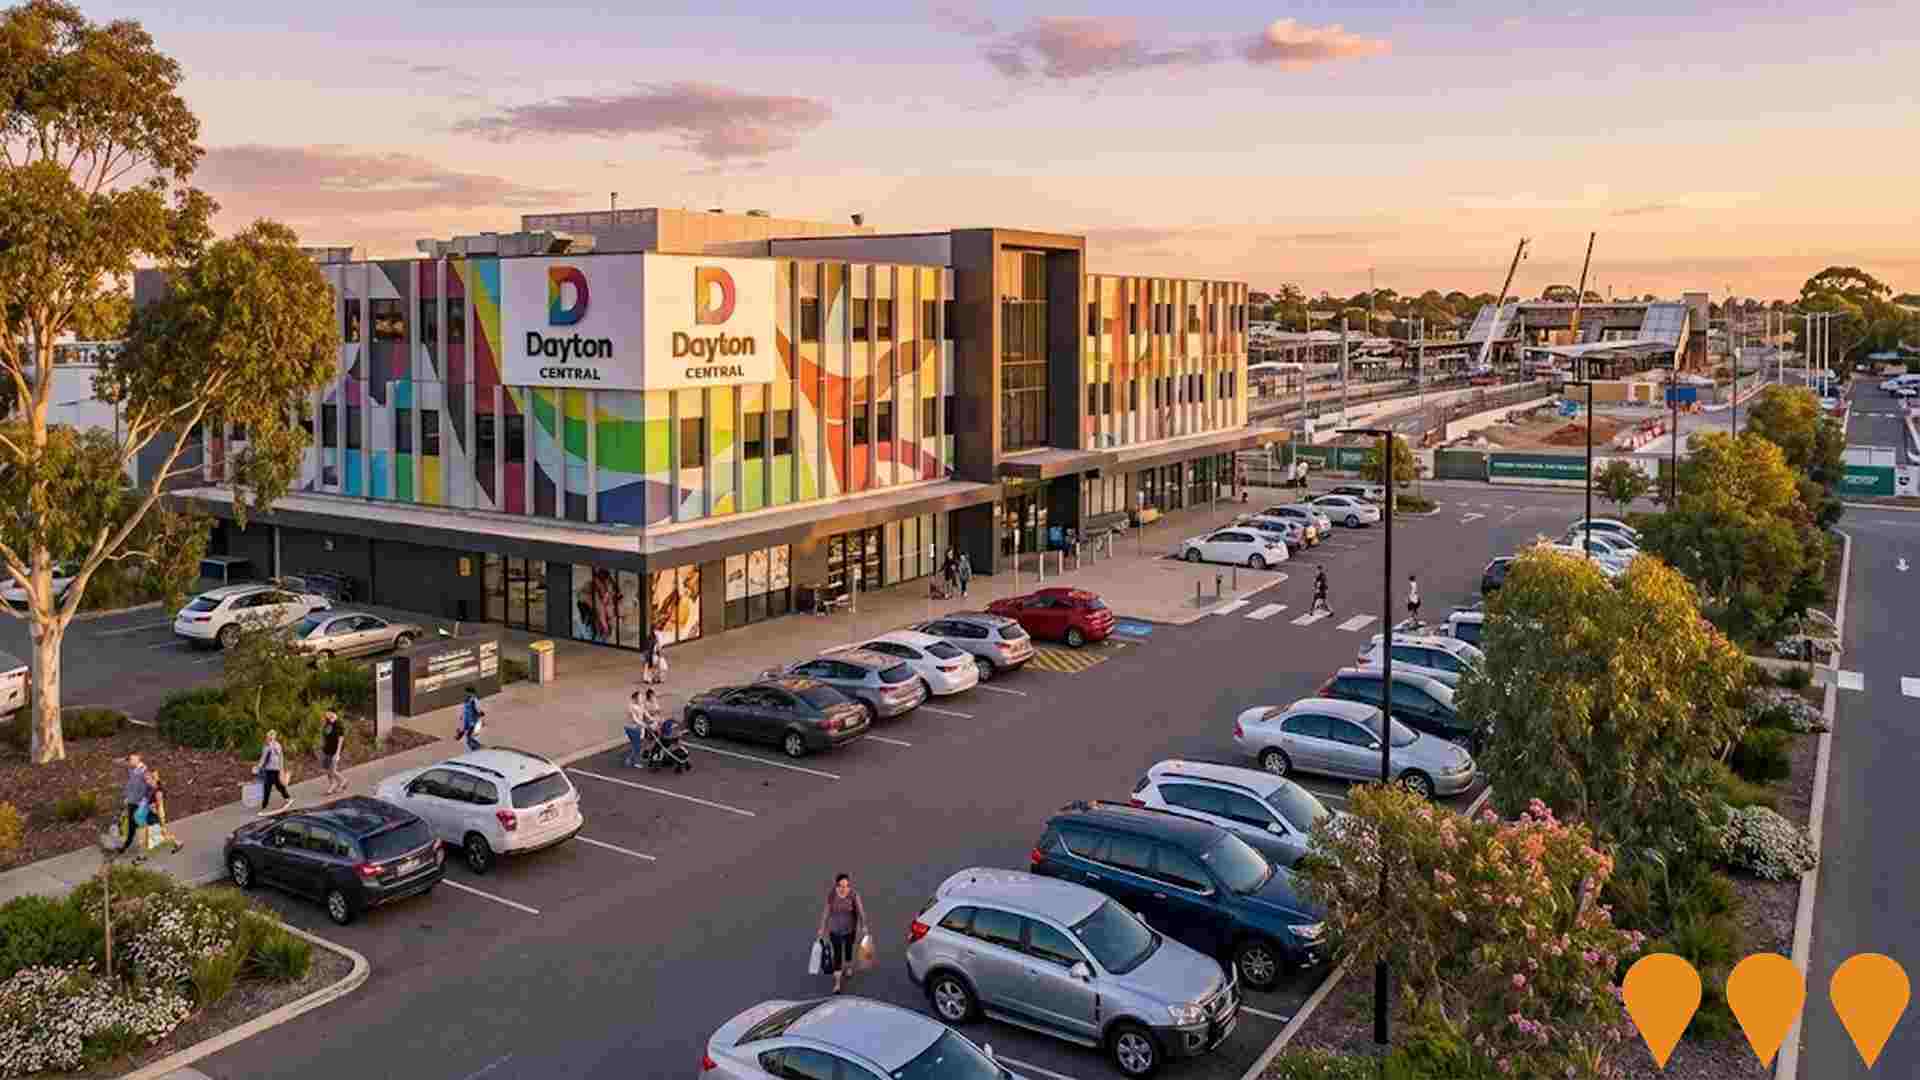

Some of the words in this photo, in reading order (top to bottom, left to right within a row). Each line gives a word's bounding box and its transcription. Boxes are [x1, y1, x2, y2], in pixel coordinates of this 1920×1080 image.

[526, 332, 613, 363] Dayton
[672, 332, 756, 363] Dayton
[539, 367, 600, 381] CENTRAL
[685, 365, 745, 379] CENTRAL
